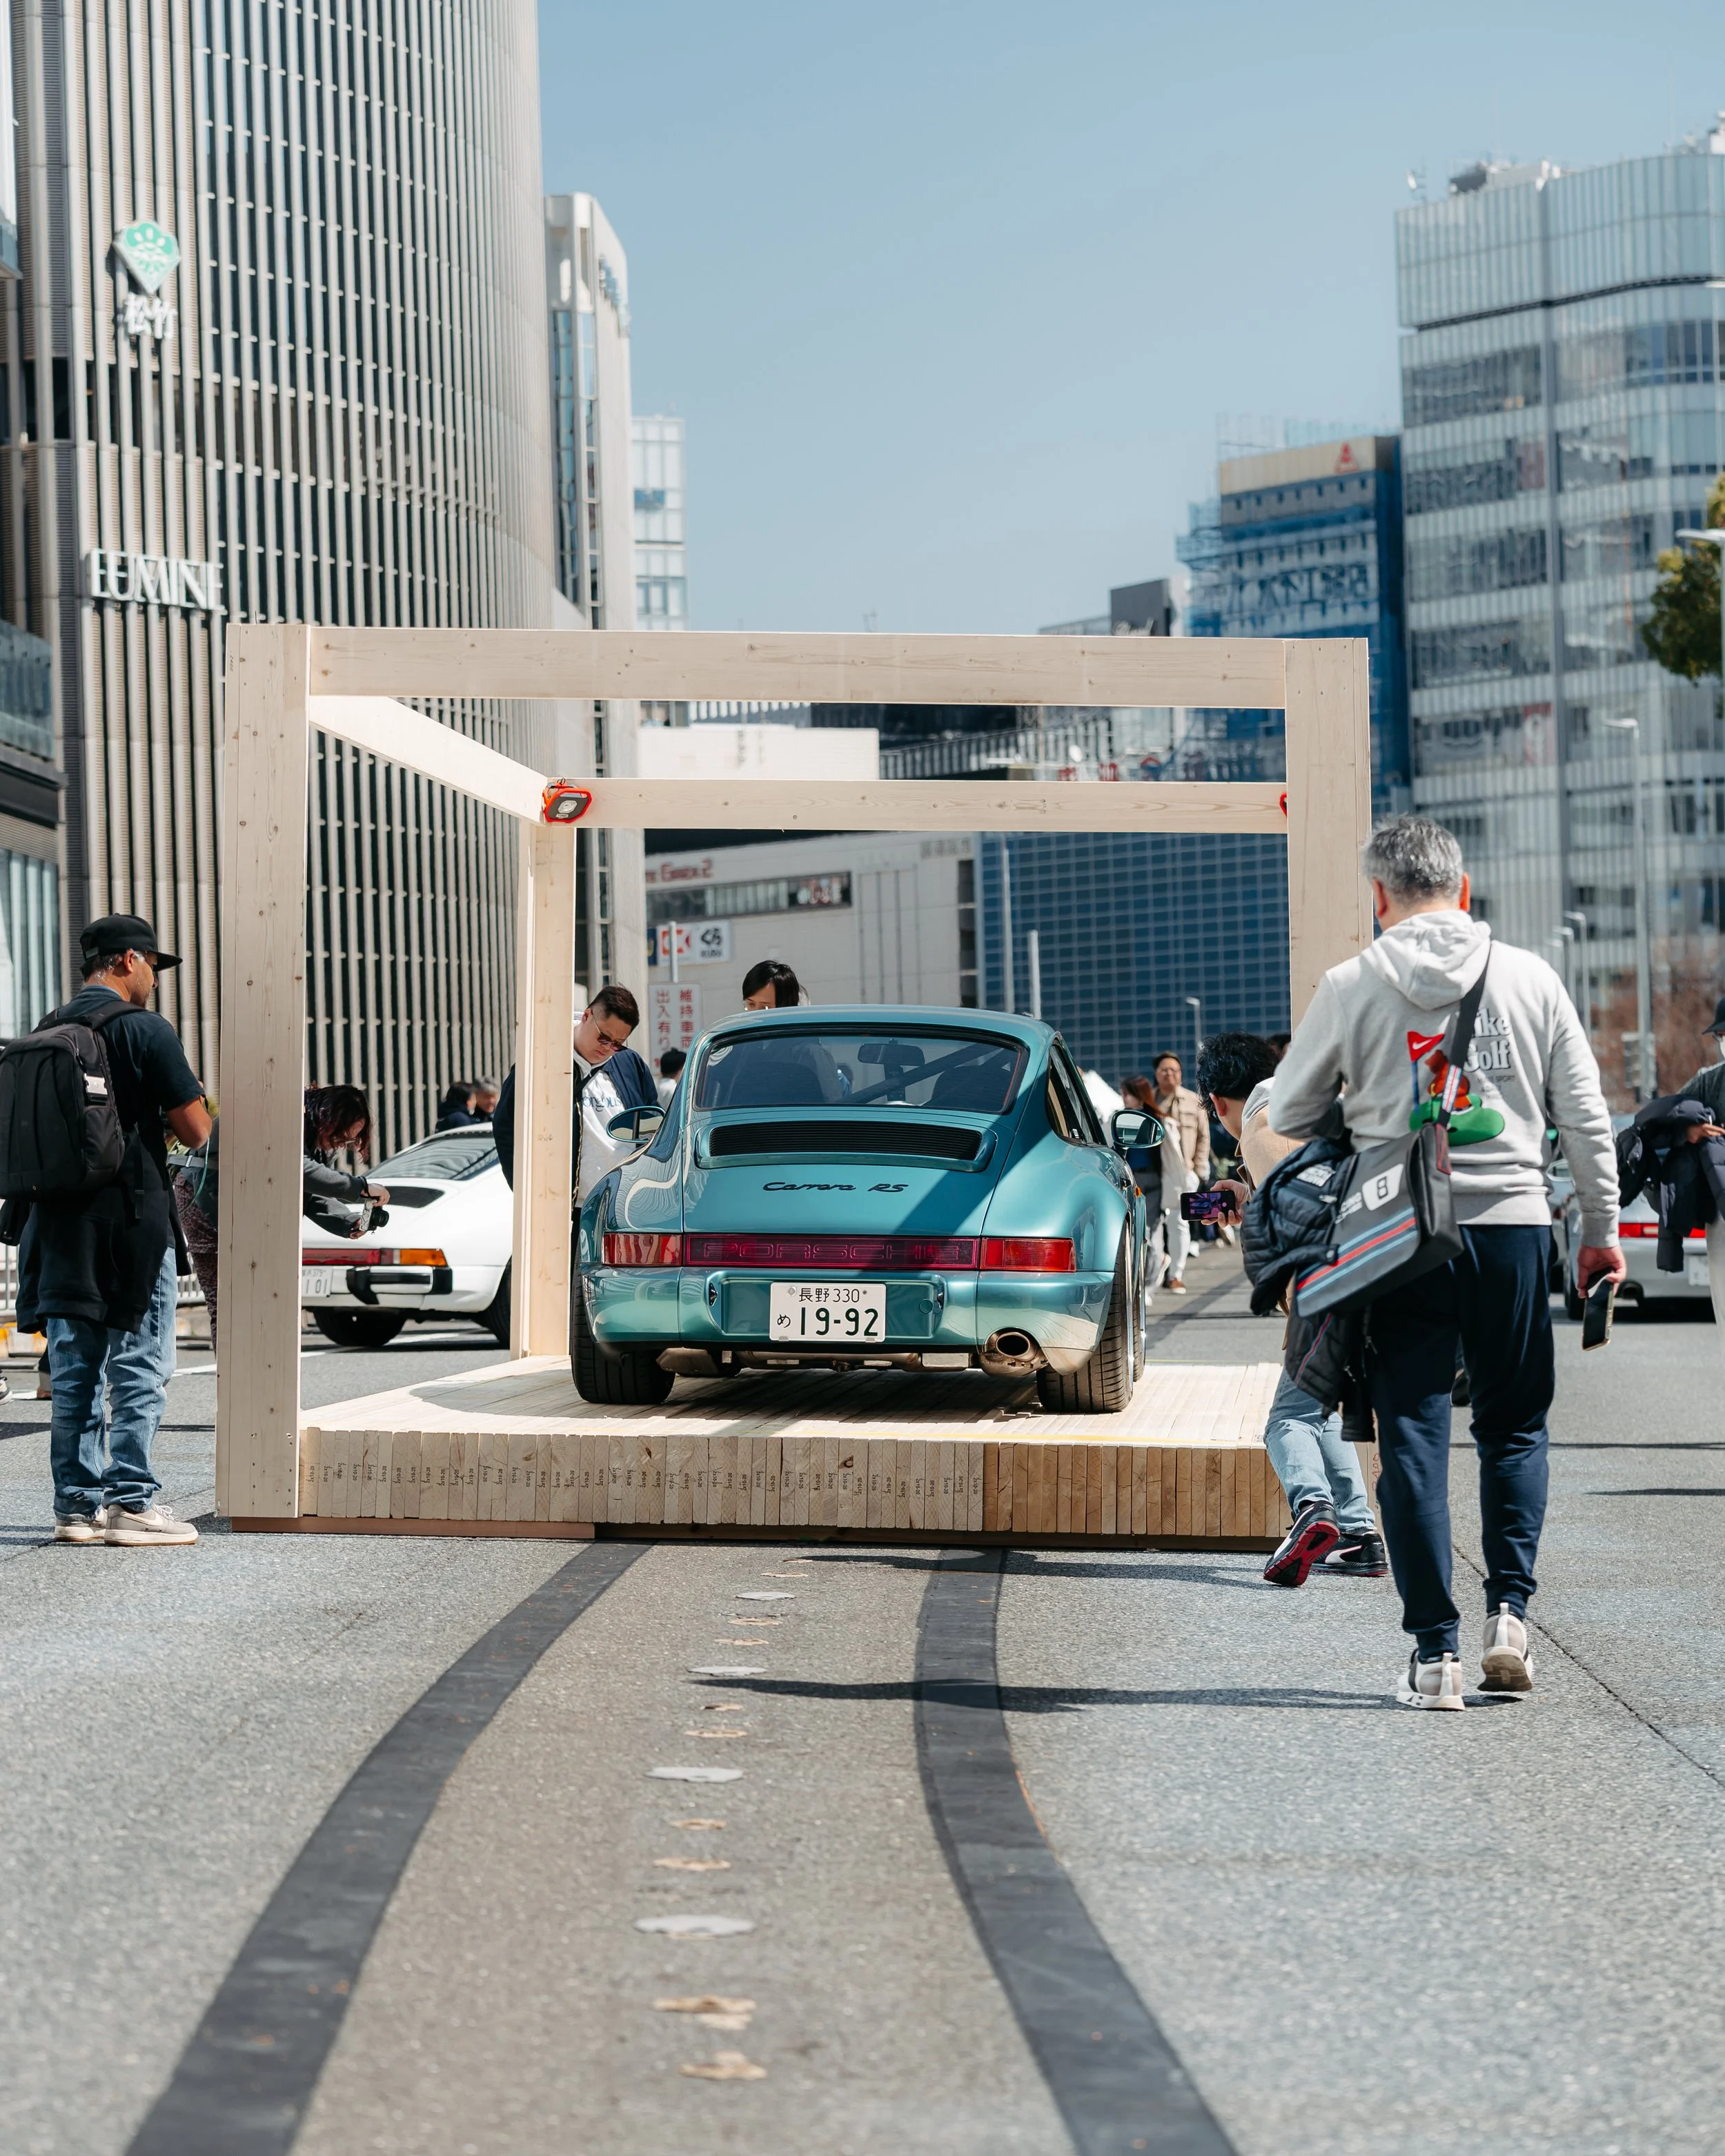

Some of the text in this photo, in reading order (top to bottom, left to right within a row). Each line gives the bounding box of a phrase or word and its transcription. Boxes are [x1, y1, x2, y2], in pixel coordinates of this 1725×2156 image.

[91, 549, 224, 611] LUMINE
[657, 990, 671, 1050] 出入有り
[1472, 1008, 1510, 1038] ike
[762, 1182, 909, 1192] Carrera RS
[703, 1243, 960, 1260] PORSCHE
[777, 1314, 791, 1328] め
[800, 1307, 878, 1336] 19-92
